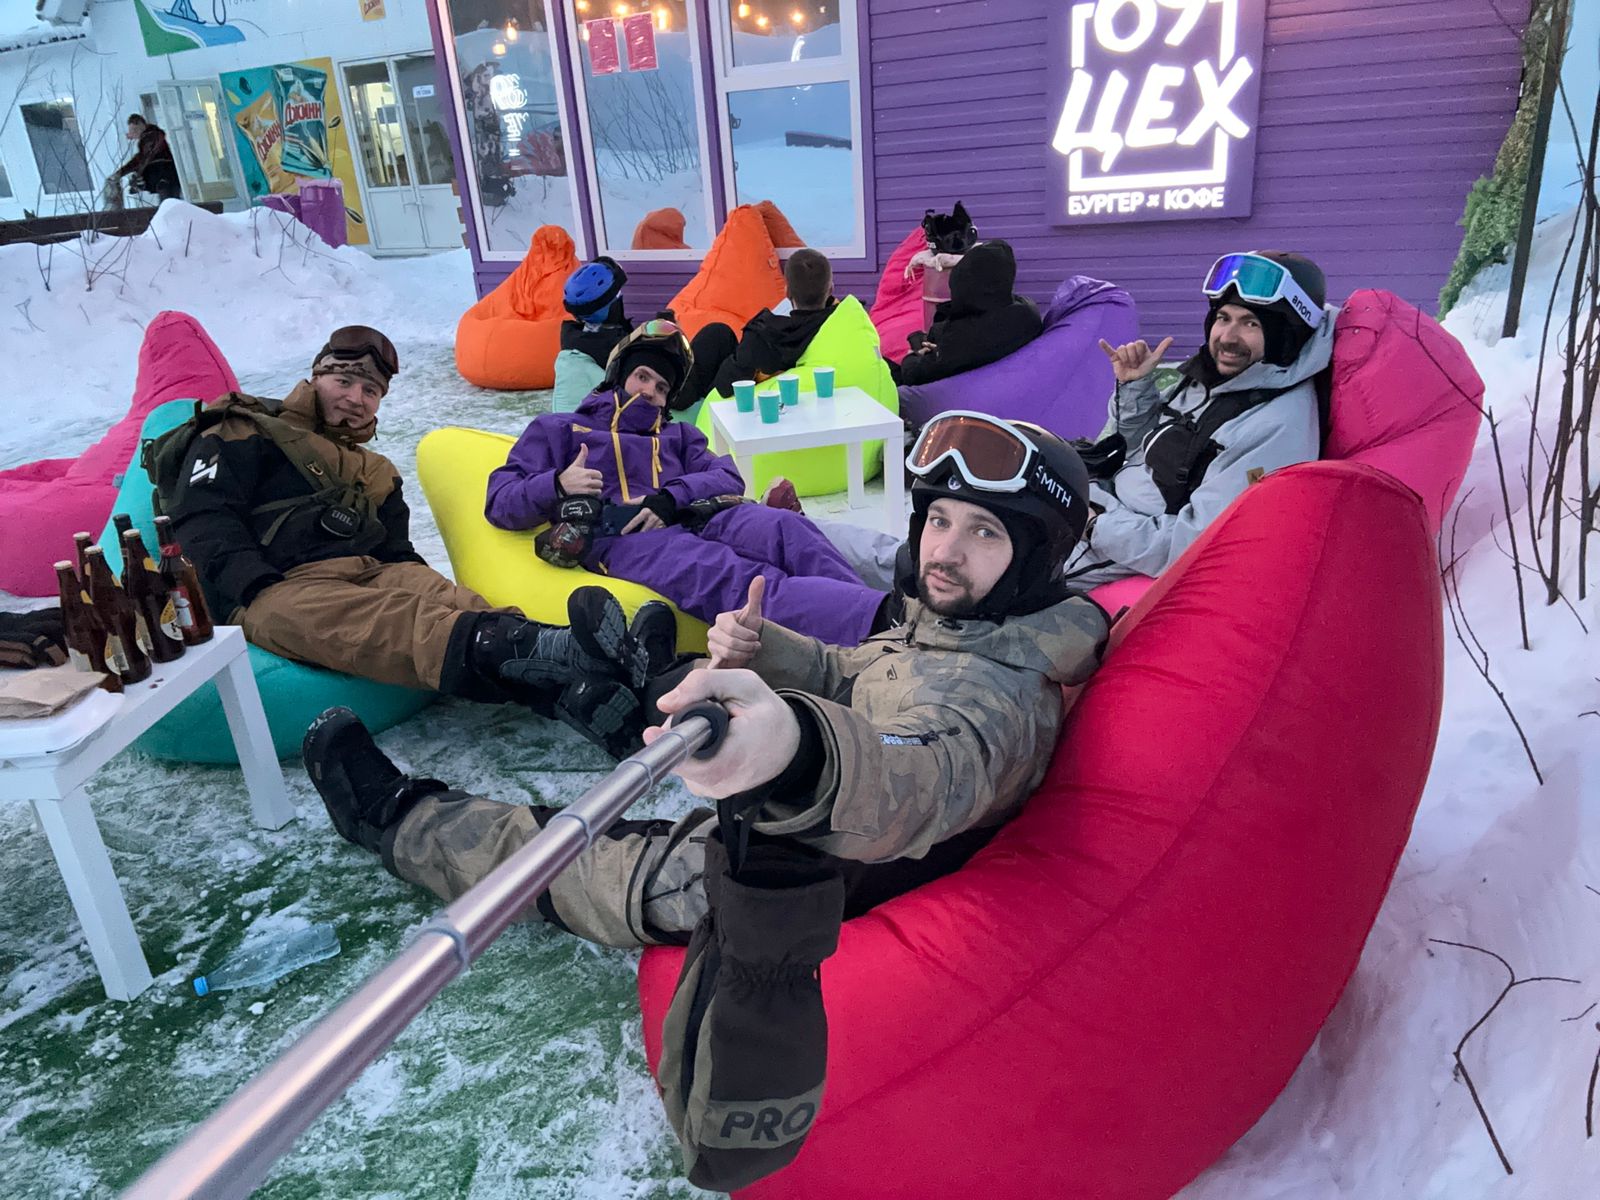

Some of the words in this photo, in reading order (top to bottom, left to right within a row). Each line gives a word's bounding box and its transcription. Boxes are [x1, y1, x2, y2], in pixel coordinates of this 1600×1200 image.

[1052, 57, 1254, 173] ЦЕХ
[1068, 191, 1145, 215] БУРГЕР
[1164, 186, 1225, 210] КОФЕ
[1292, 295, 1312, 322] anon
[1035, 465, 1072, 508] SMITH
[720, 1102, 816, 1142] PRO
